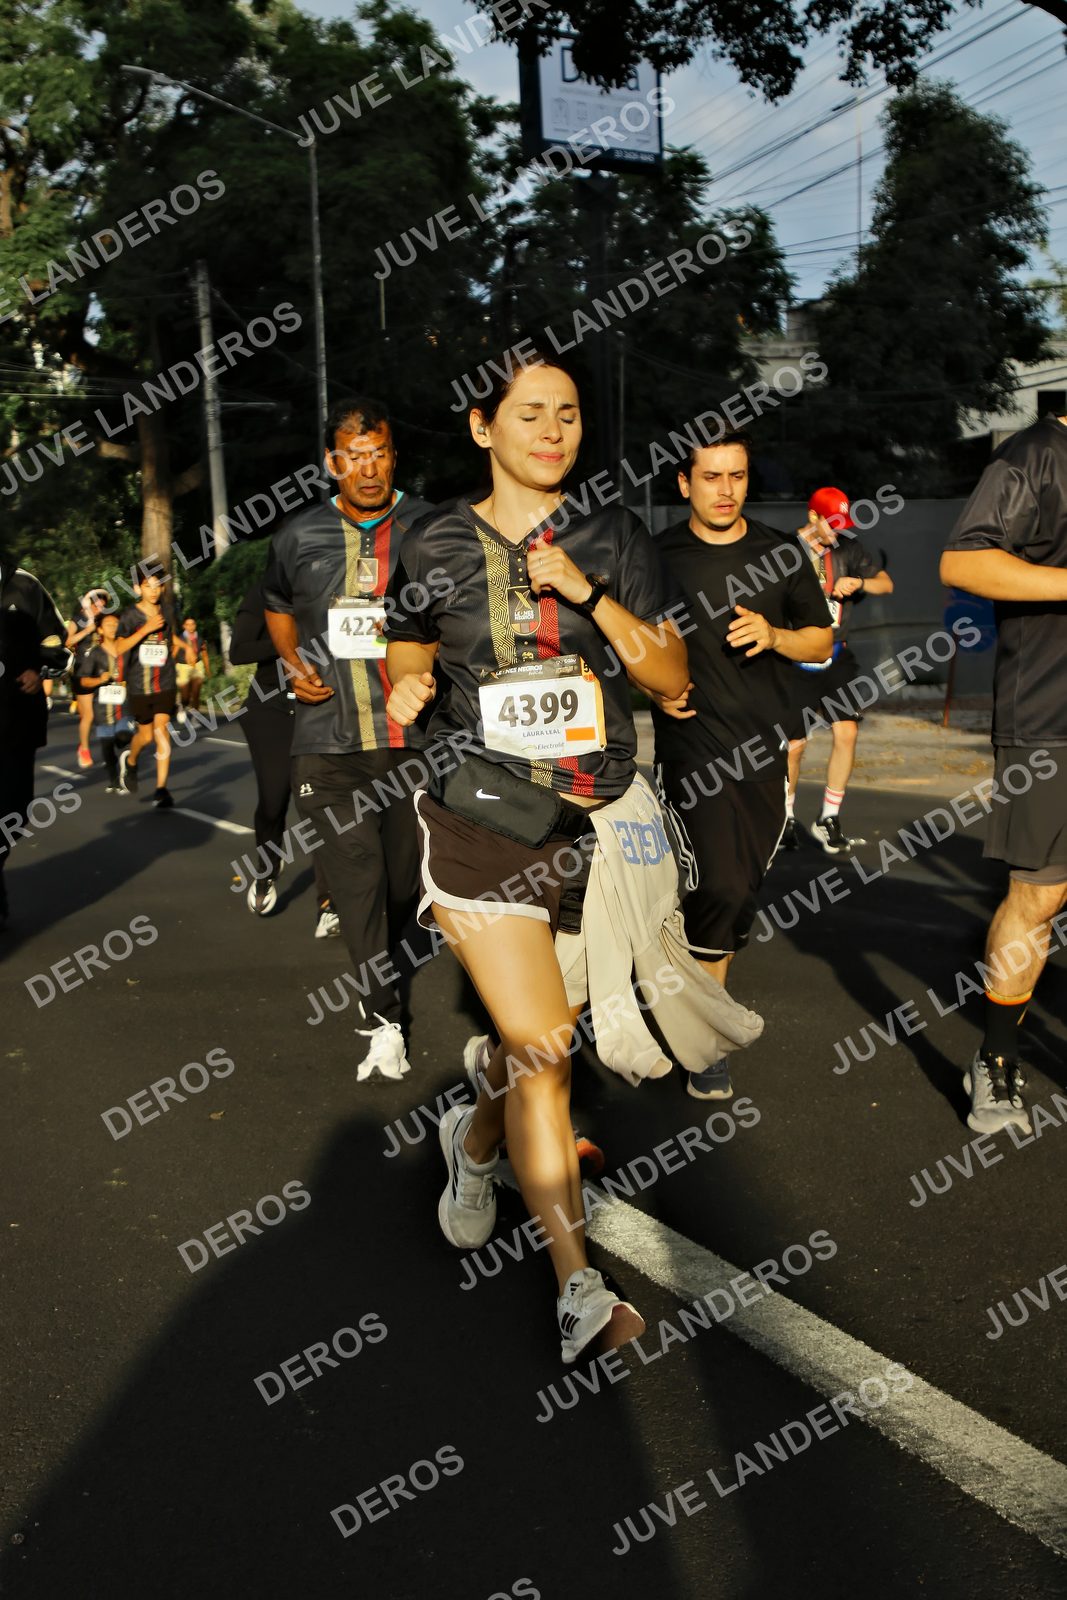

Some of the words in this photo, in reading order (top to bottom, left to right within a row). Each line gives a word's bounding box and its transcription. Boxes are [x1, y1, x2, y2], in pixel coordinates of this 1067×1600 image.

[339, 615, 386, 637] 422
[498, 689, 579, 728] 4399
[522, 730, 545, 738] LAURA
[545, 728, 560, 736] LEAL
